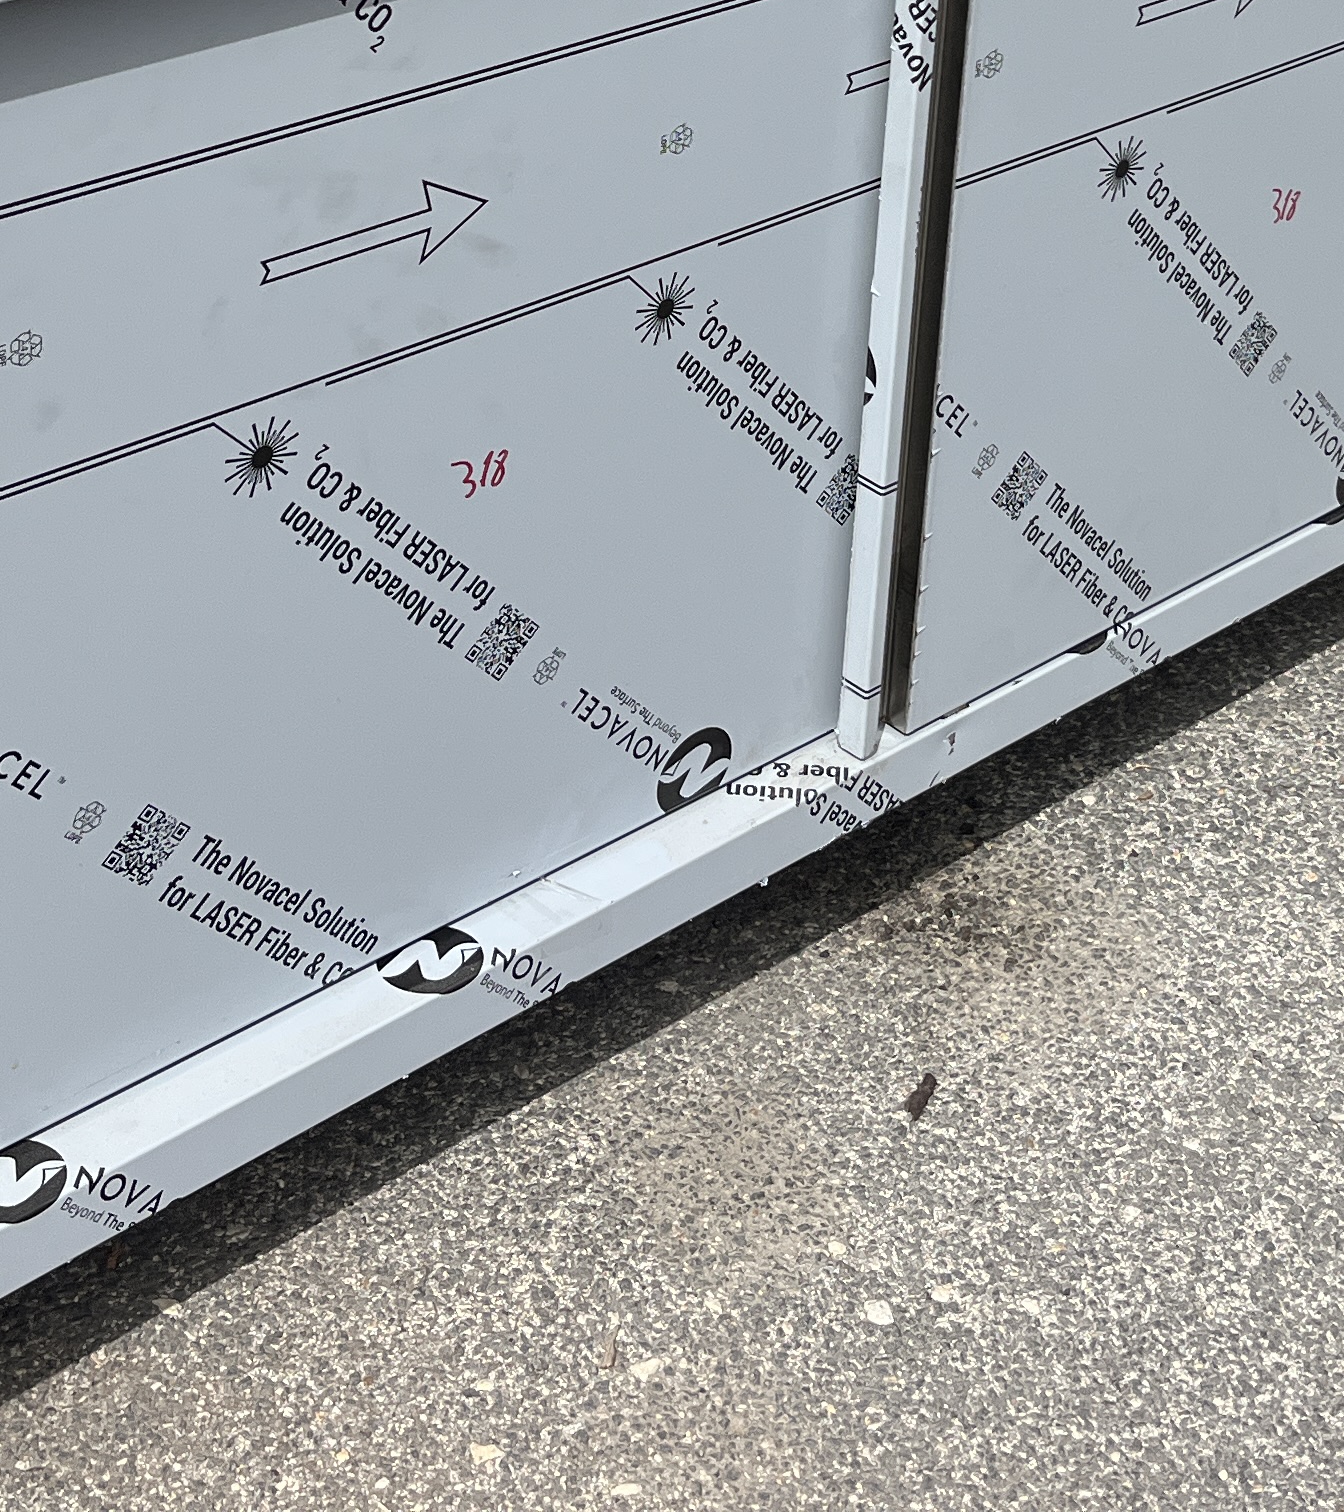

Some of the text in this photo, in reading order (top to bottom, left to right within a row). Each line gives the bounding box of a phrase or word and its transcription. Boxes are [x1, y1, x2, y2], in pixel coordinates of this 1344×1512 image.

[1163, 196, 1180, 221] &
[1174, 210, 1208, 256] Fiber
[1126, 208, 1233, 346] The Novacel Solution
[1198, 241, 1240, 297] LASER
[1233, 283, 1254, 316] for
[698, 299, 844, 460] for LASER Fiber & CO2
[676, 350, 818, 494] The Novacel Solution
[450, 448, 510, 499] 318
[306, 443, 497, 612] for LASER Fiber & CO2
[1044, 483, 1153, 602] The Novacel Solution
[280, 500, 467, 650] The Novacel Solution
[1021, 514, 1045, 547] for
[1039, 532, 1084, 583] LASER
[1078, 569, 1109, 609] Fiber
[1102, 595, 1119, 619] &
[570, 687, 672, 773] NOVACEL
[610, 685, 682, 744] Beyond The Surface
[726, 782, 828, 826] Solution
[772, 761, 865, 793] Fiber &
[158, 875, 325, 979] for LASER Fiber &
[190, 834, 380, 956] The Novacel Solution
[479, 972, 531, 1009] Beyond The
[60, 1196, 126, 1233] Beyond The
